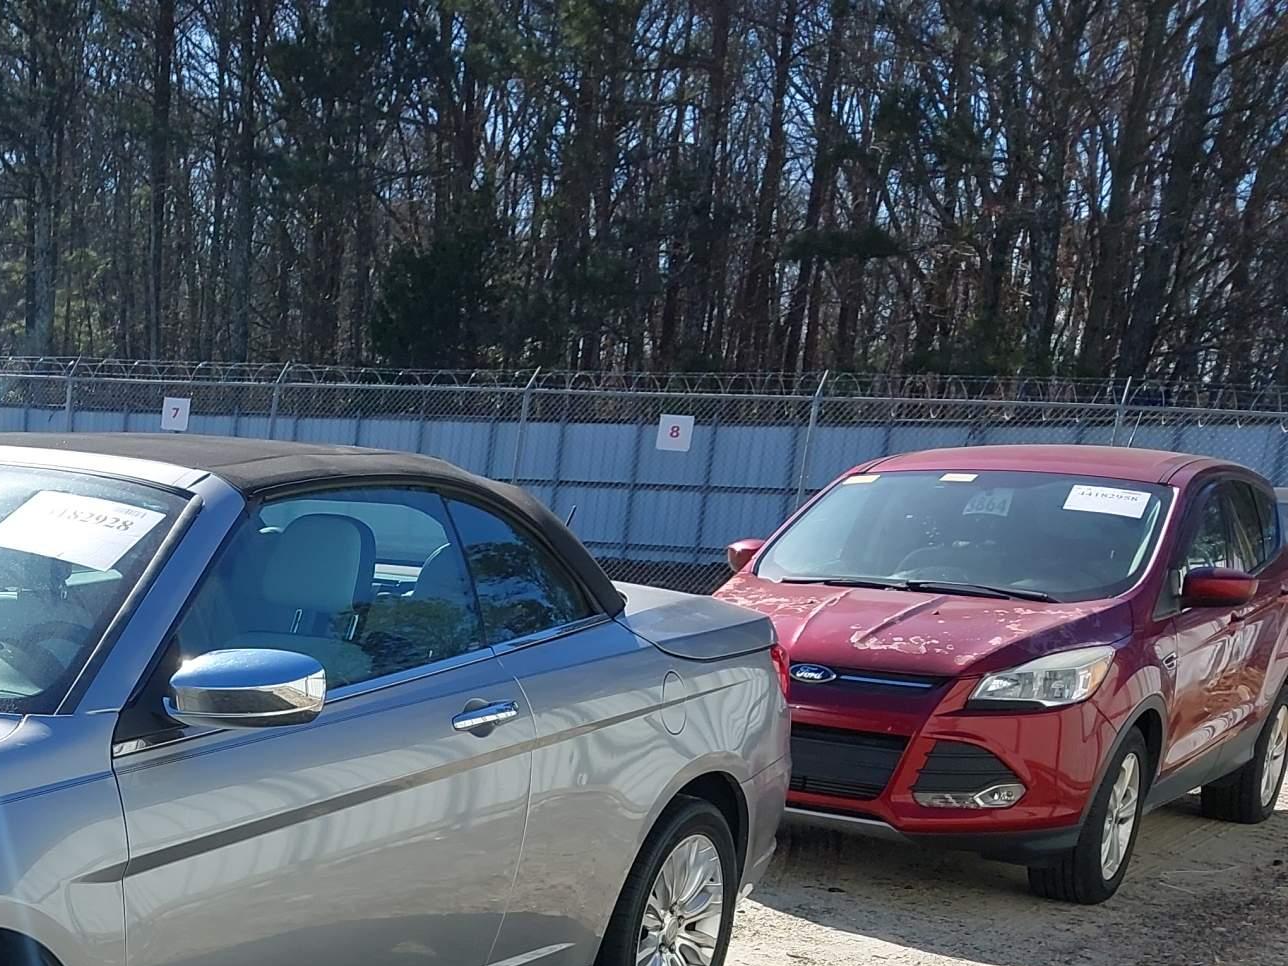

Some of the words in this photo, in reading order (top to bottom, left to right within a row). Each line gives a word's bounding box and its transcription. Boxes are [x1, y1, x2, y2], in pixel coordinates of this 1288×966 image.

[171, 407, 180, 418] 7
[669, 425, 680, 438] 8
[795, 665, 825, 680] Ford
